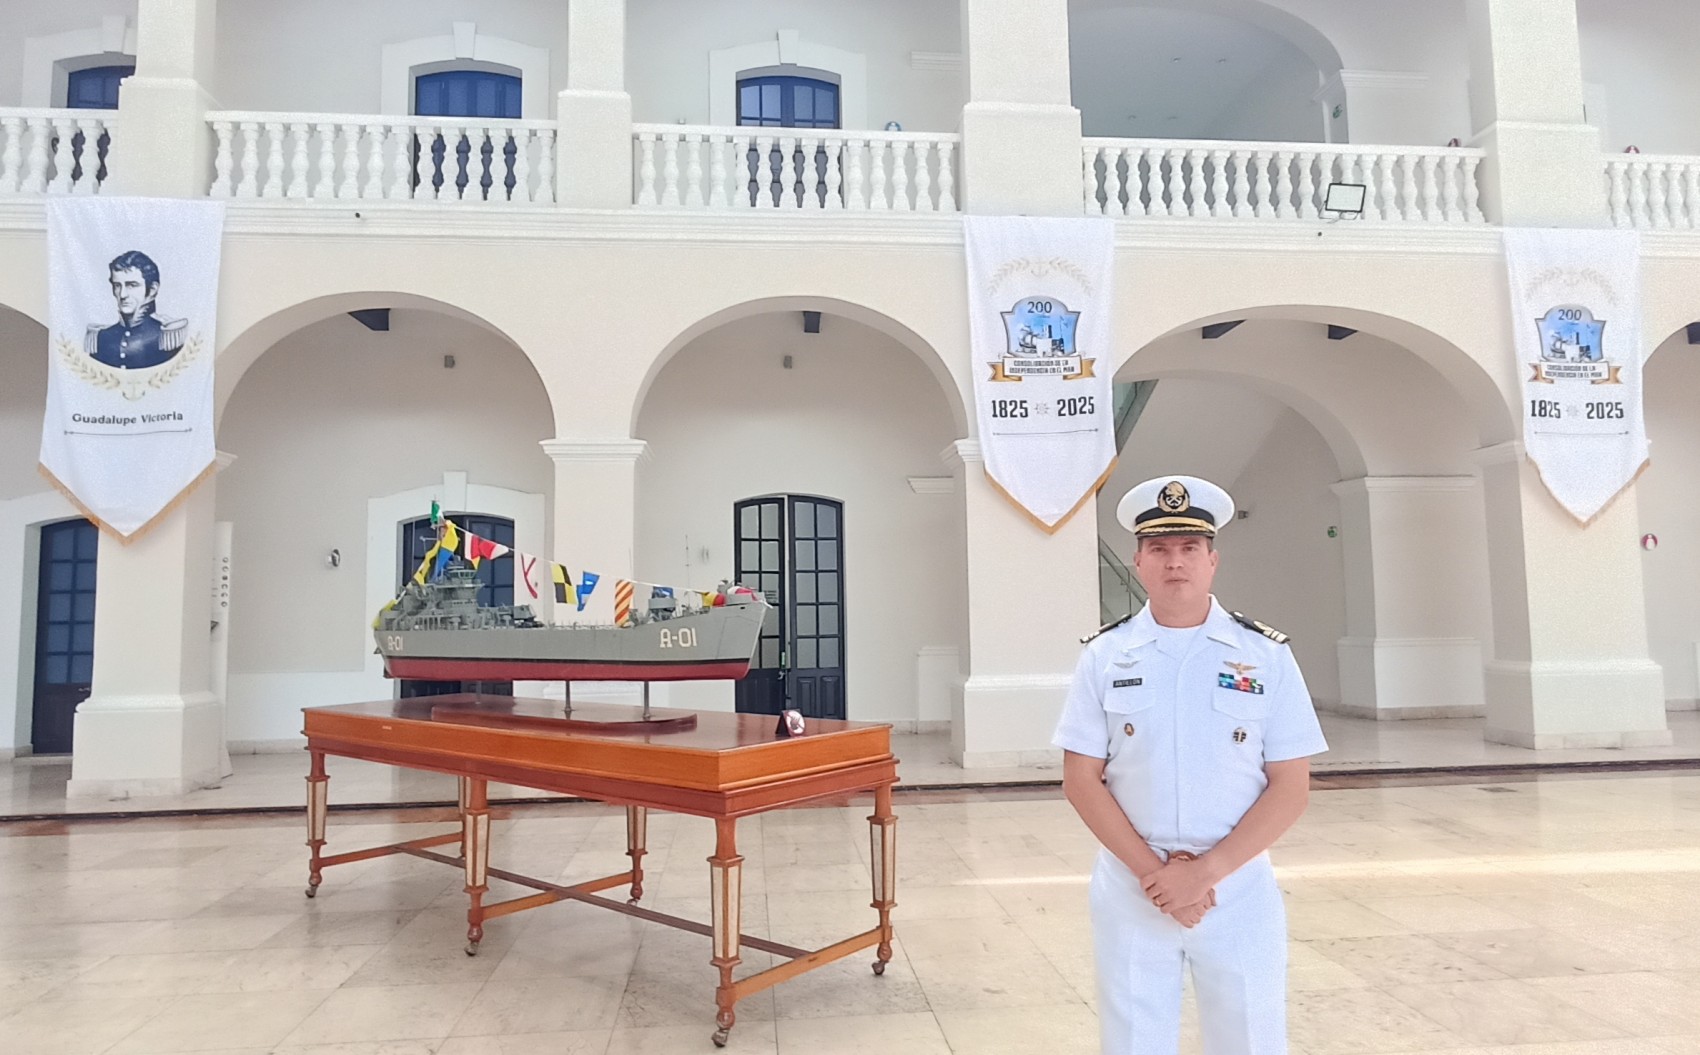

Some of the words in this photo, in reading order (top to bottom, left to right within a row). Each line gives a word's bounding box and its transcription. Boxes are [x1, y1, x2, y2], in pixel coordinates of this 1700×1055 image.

[1027, 301, 1052, 314] 200
[1558, 309, 1582, 321] 200
[991, 400, 1028, 418] 1825
[1057, 396, 1095, 417] 2025
[1530, 400, 1561, 419] 1825
[1585, 402, 1624, 419] 2025
[72, 413, 137, 426] Guadalupe
[141, 411, 184, 423] Victoria
[659, 627, 697, 649] A-01
